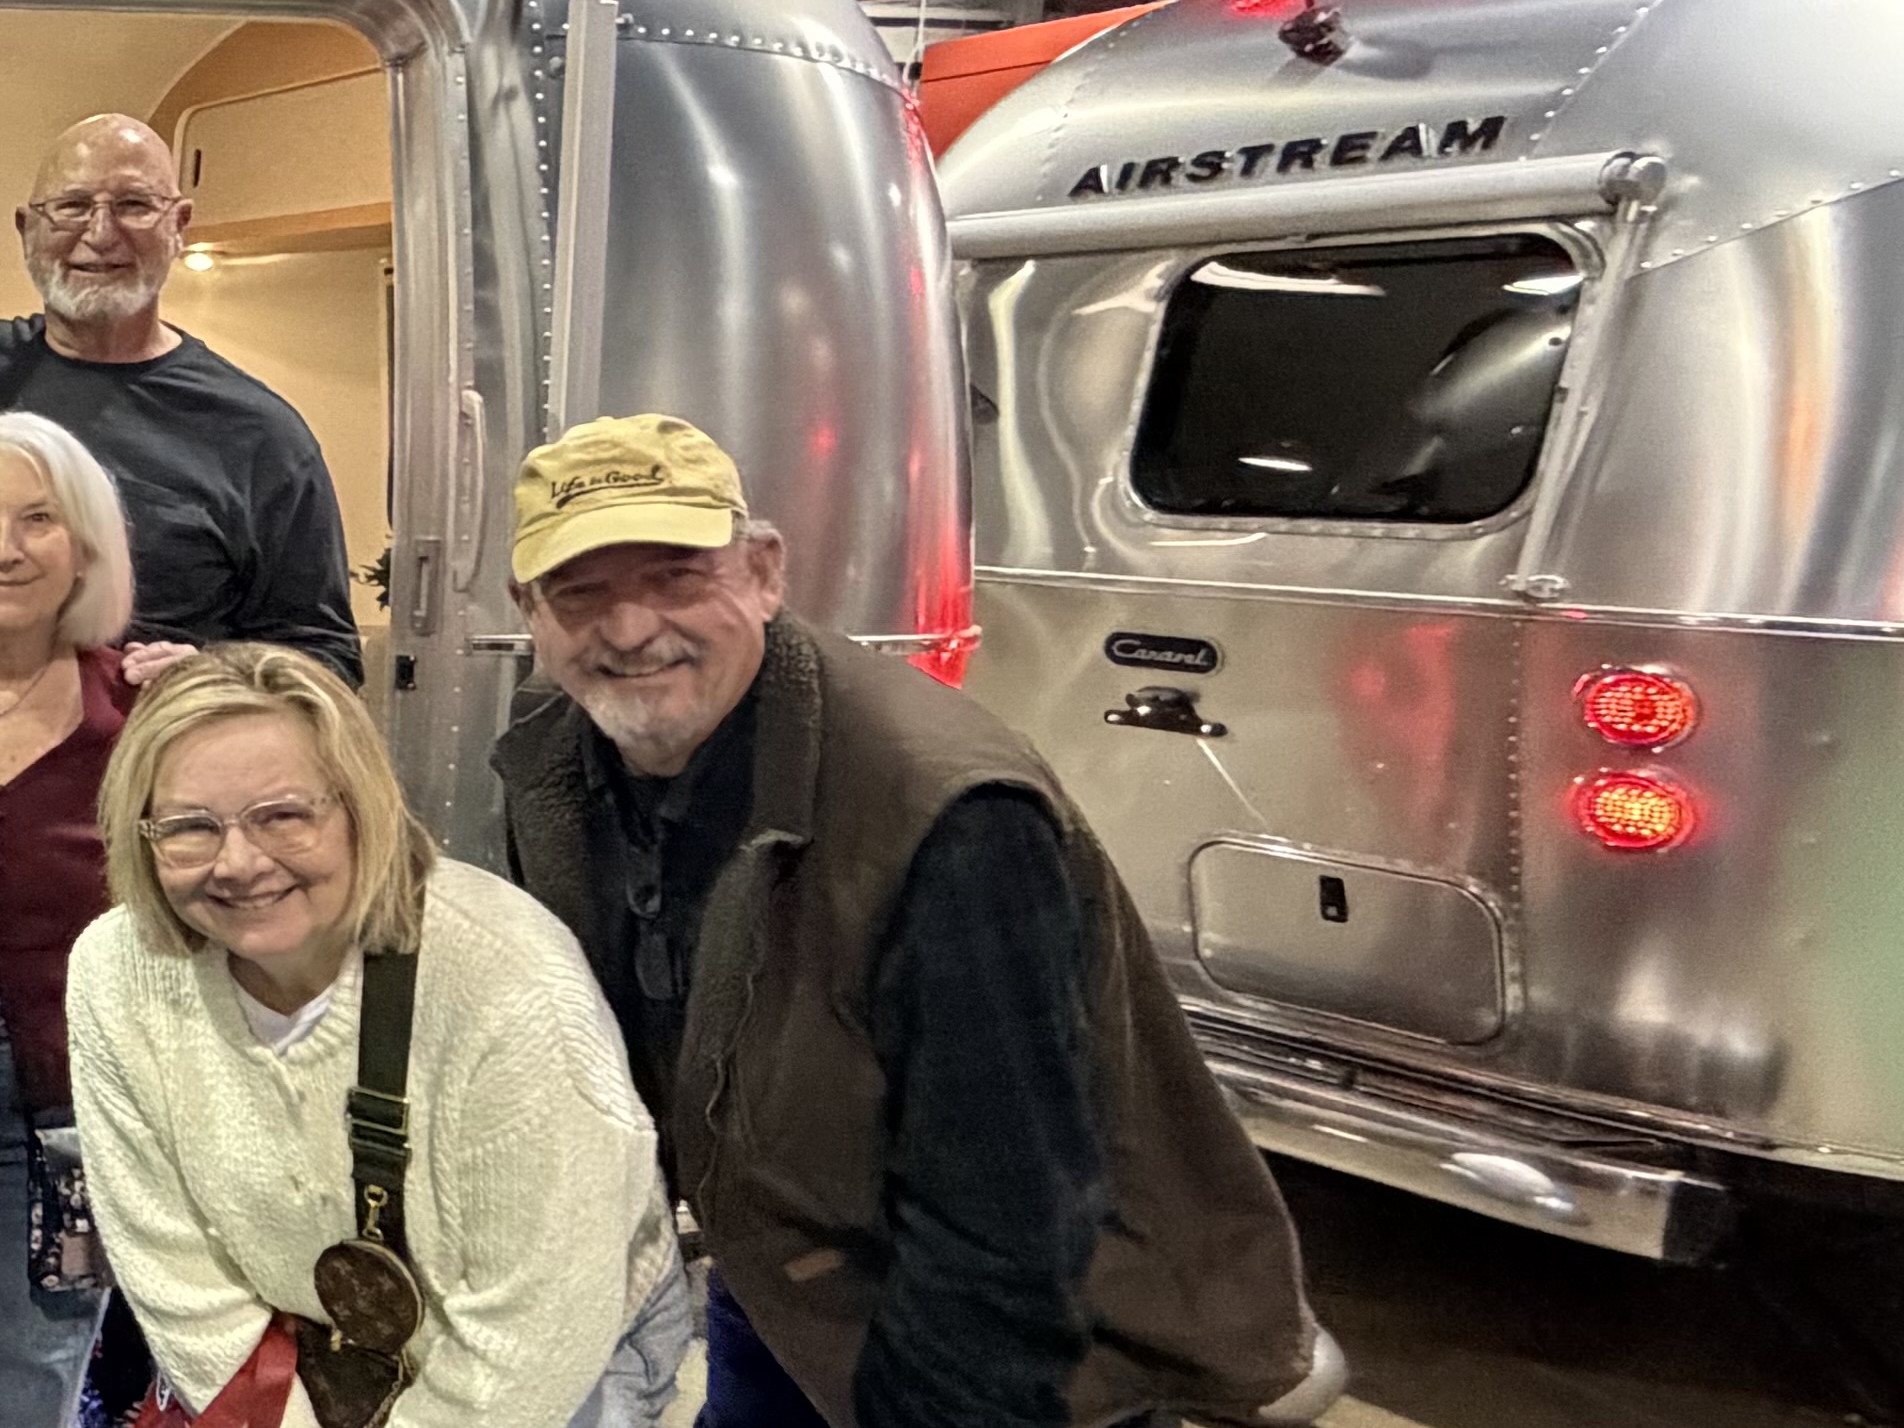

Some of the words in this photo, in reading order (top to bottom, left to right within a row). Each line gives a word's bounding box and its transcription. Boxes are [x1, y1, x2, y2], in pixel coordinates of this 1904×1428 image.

[1067, 115, 1506, 197] AIRSTREAM
[550, 475, 586, 500] Life
[605, 464, 665, 484] Good
[1111, 638, 1209, 666] Caravel
